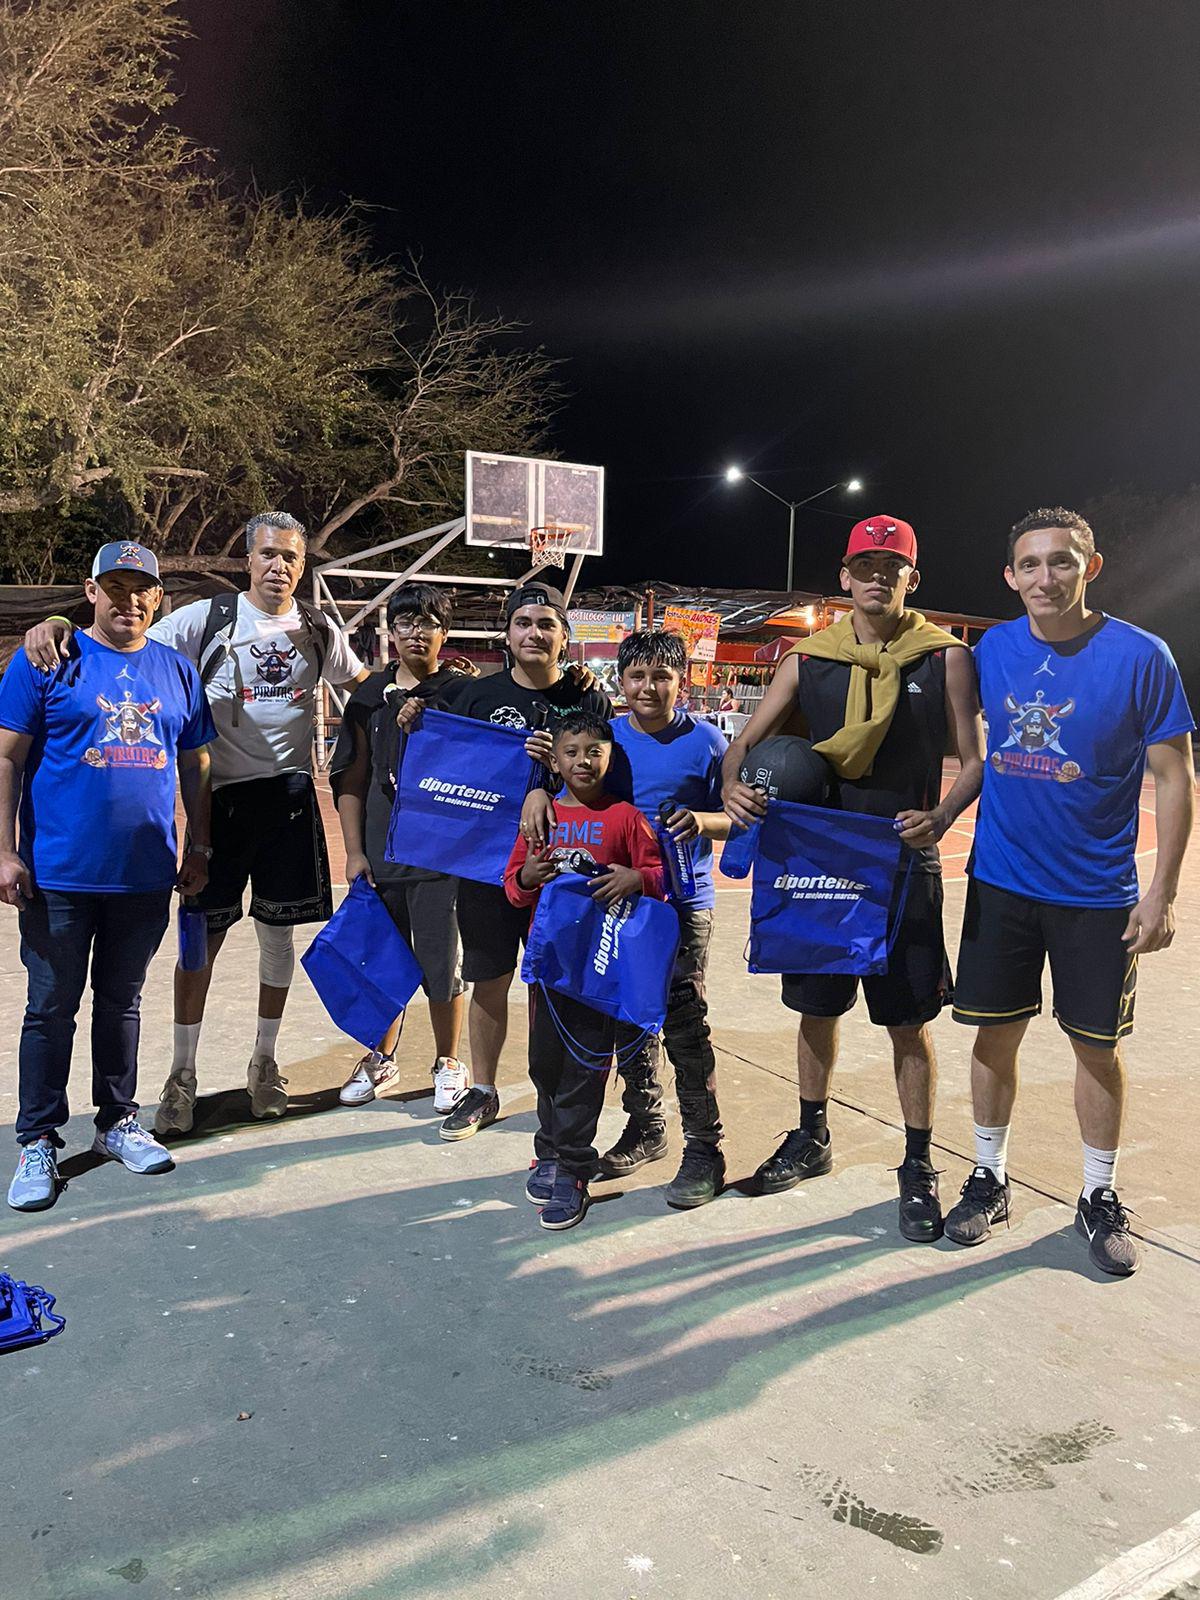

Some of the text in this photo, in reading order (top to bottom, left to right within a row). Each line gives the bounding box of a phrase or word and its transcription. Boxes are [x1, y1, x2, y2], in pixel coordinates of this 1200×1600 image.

[253, 686, 294, 700] PIRATAS
[445, 797, 471, 807] mejores
[470, 802, 494, 811] marcas
[804, 891, 833, 900] mejores
